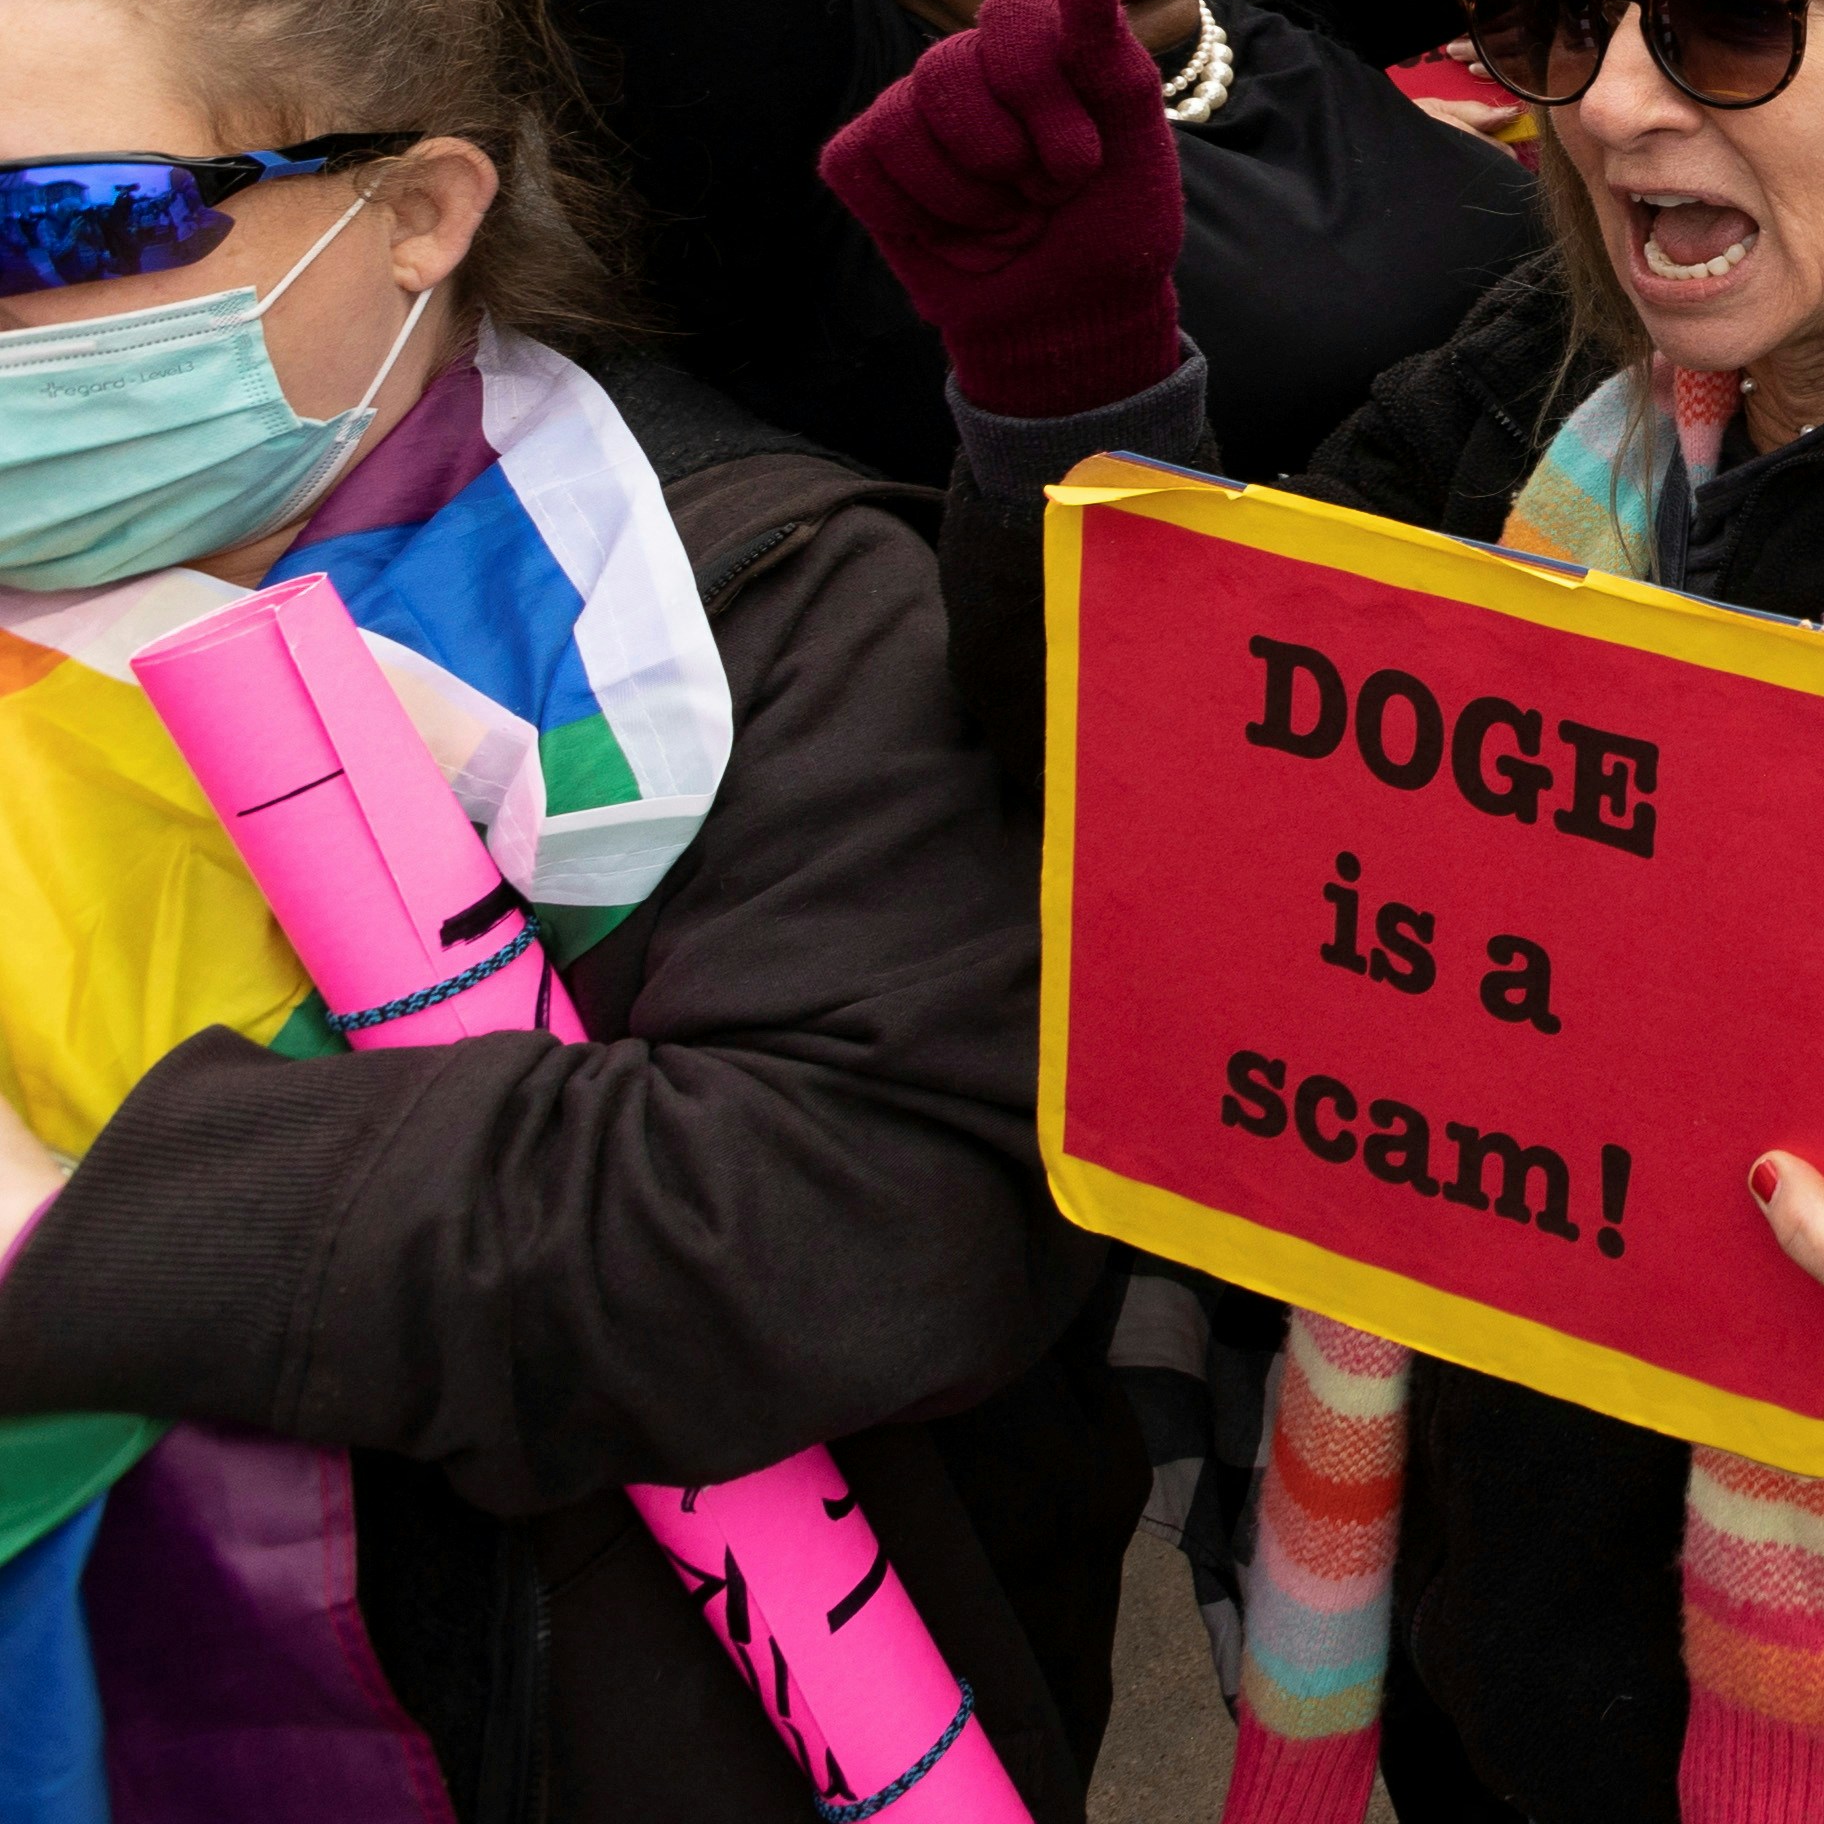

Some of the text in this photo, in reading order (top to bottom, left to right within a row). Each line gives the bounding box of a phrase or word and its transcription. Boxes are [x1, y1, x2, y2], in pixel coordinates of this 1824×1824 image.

[1244, 634, 1661, 860] DOGE
[1319, 850, 1563, 1036] is a
[1219, 1048, 1634, 1259] scam!
